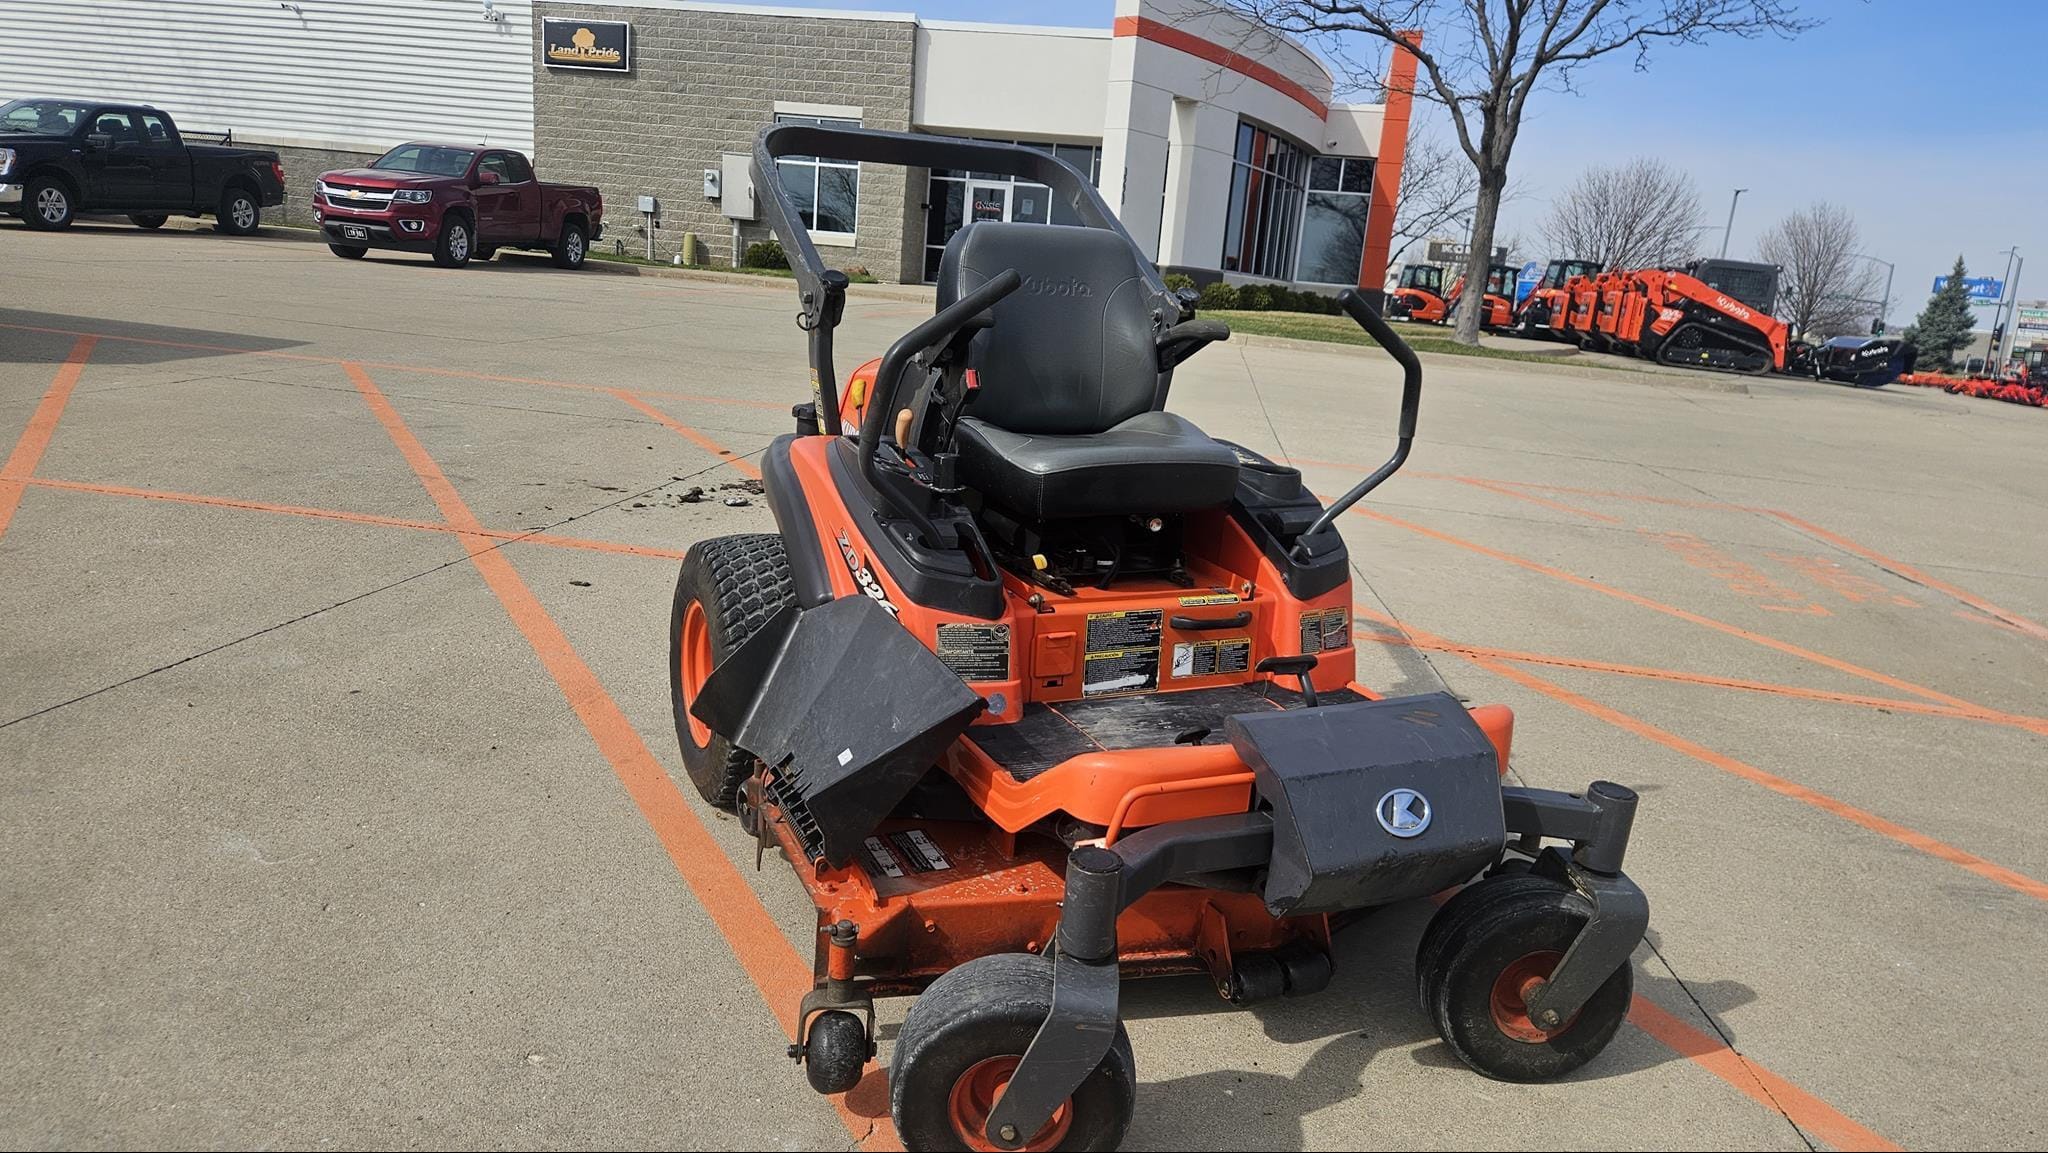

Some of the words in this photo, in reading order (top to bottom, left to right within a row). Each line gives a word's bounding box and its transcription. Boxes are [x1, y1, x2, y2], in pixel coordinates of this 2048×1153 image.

[550, 43, 579, 55] Land
[588, 46, 620, 58] Pride
[1717, 295, 1750, 319] Kubota
